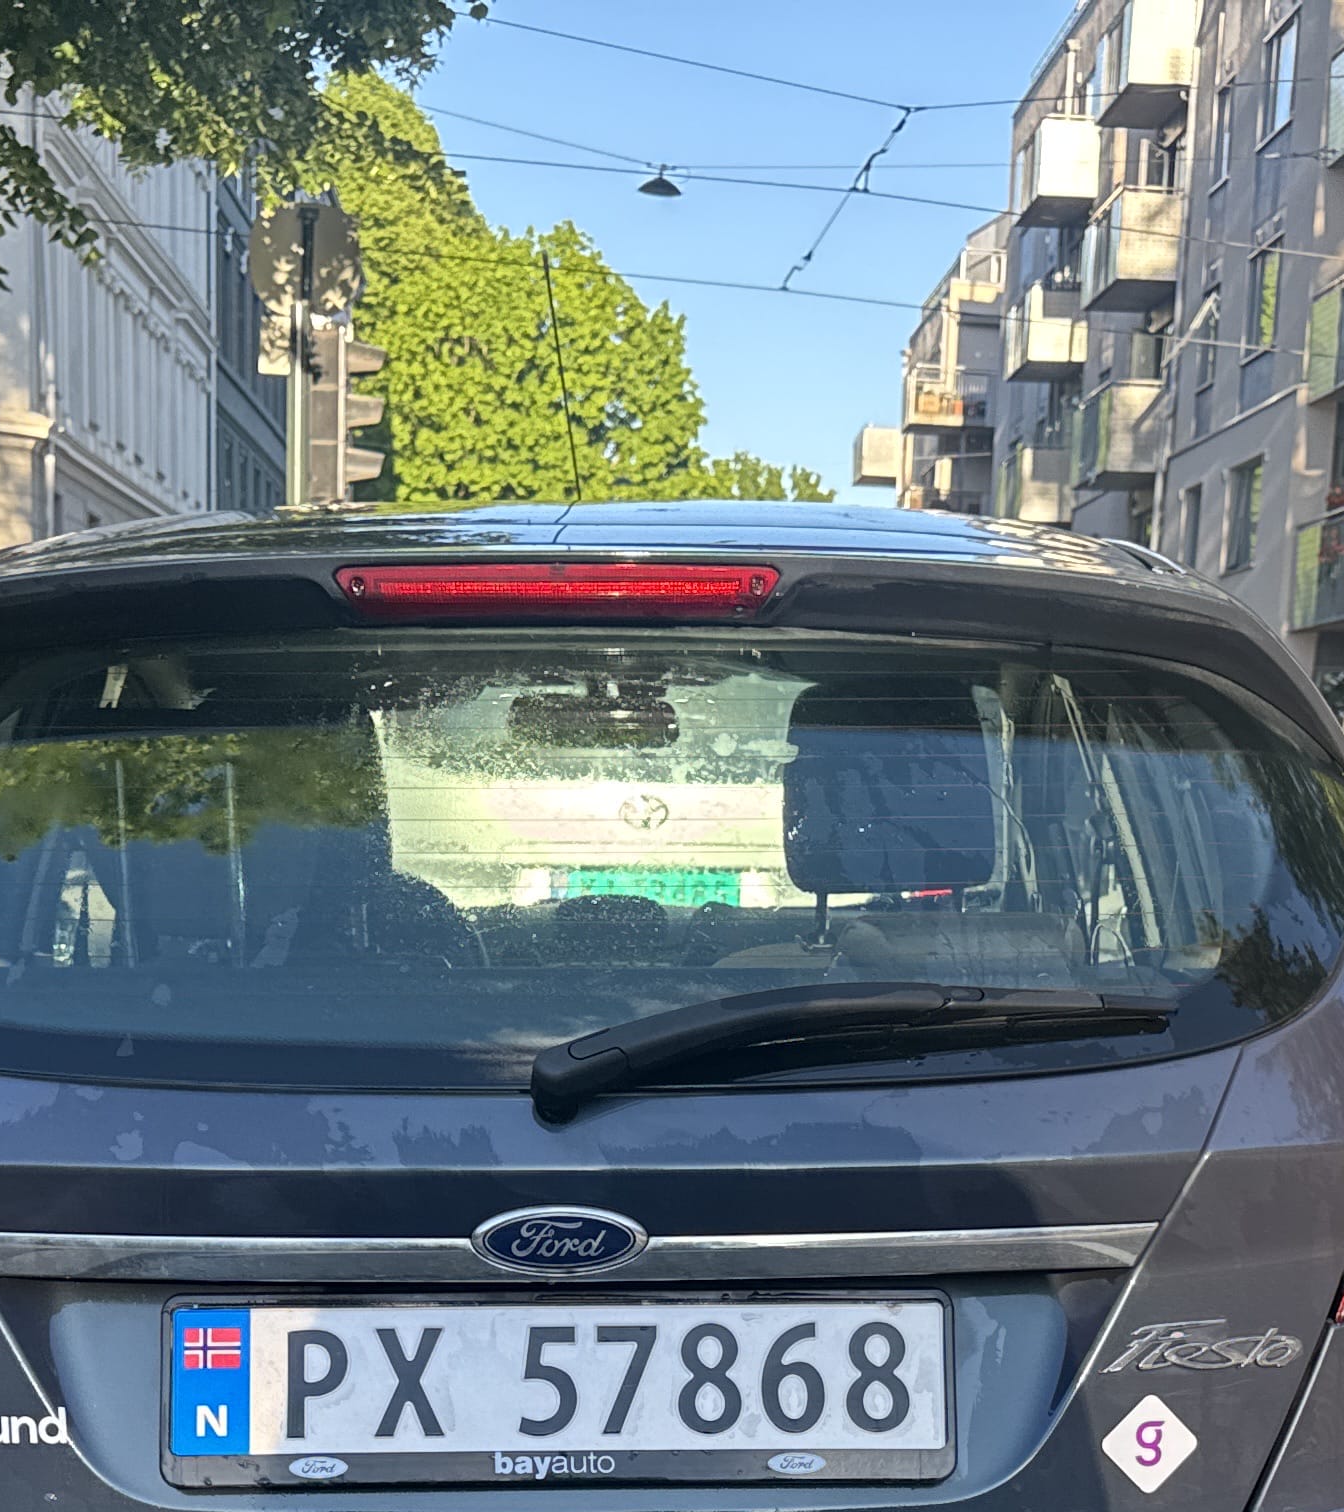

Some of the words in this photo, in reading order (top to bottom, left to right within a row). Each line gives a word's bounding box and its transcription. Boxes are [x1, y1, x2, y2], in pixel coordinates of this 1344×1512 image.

[510, 1219, 607, 1258] Ford
[1097, 1317, 1303, 1374] Fiesta
[286, 1327, 446, 1439] PX
[518, 1321, 911, 1436] 57868
[195, 1404, 228, 1437] N
[301, 1460, 337, 1474] Ford
[493, 1451, 616, 1480] bayauto
[779, 1455, 815, 1470] Ford
